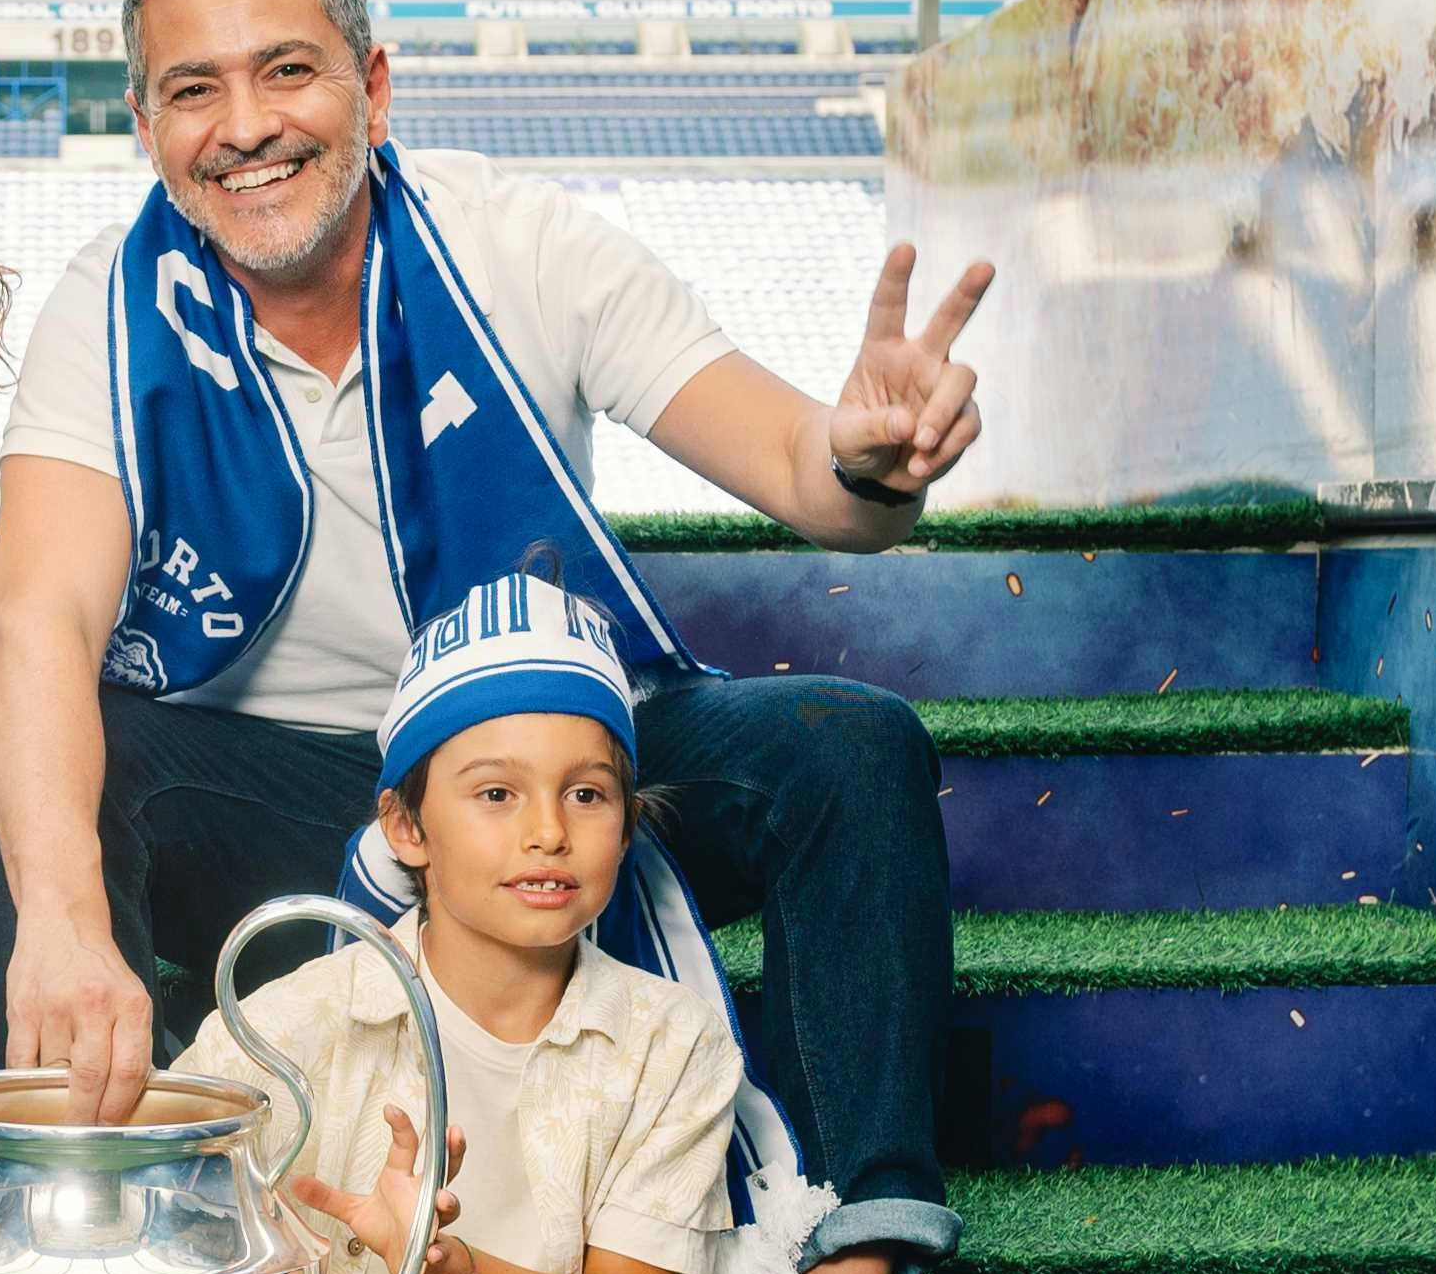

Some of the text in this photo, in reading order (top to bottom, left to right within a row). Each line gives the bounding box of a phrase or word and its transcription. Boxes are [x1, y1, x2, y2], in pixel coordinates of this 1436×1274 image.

[466, 0, 594, 20] FUTEBOL
[692, 0, 732, 20] DO
[736, 0, 832, 19] PORTO
[52, 27, 120, 55] 189
